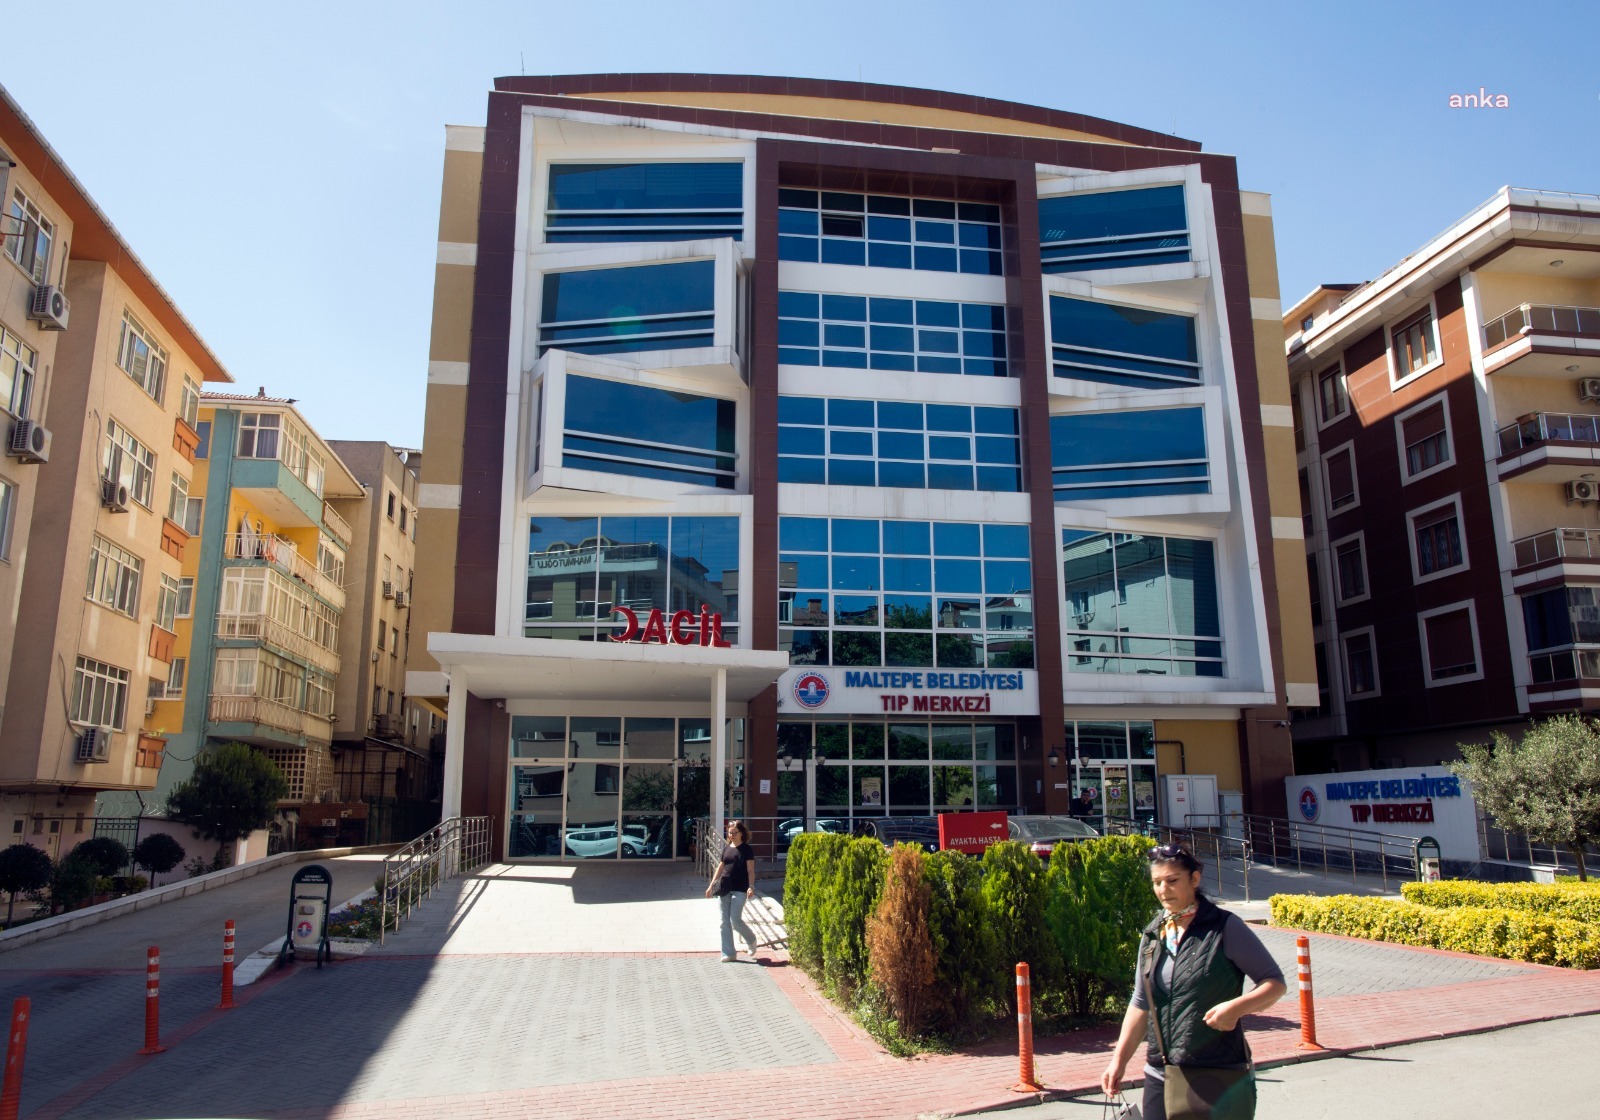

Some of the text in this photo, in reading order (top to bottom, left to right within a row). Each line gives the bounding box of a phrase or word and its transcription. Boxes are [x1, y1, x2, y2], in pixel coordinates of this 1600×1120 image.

[641, 603, 732, 648] ACİL
[845, 669, 1024, 690] MALTEPE BELEDİYESİ
[880, 692, 991, 713] TIP MERKEZİ
[1326, 780, 1380, 801] MALTEPE
[1380, 773, 1461, 799] BELEDİYESİ
[1350, 798, 1434, 823] TIP MERKEZİ
[950, 836, 1002, 846] AYAKTA HASTA
